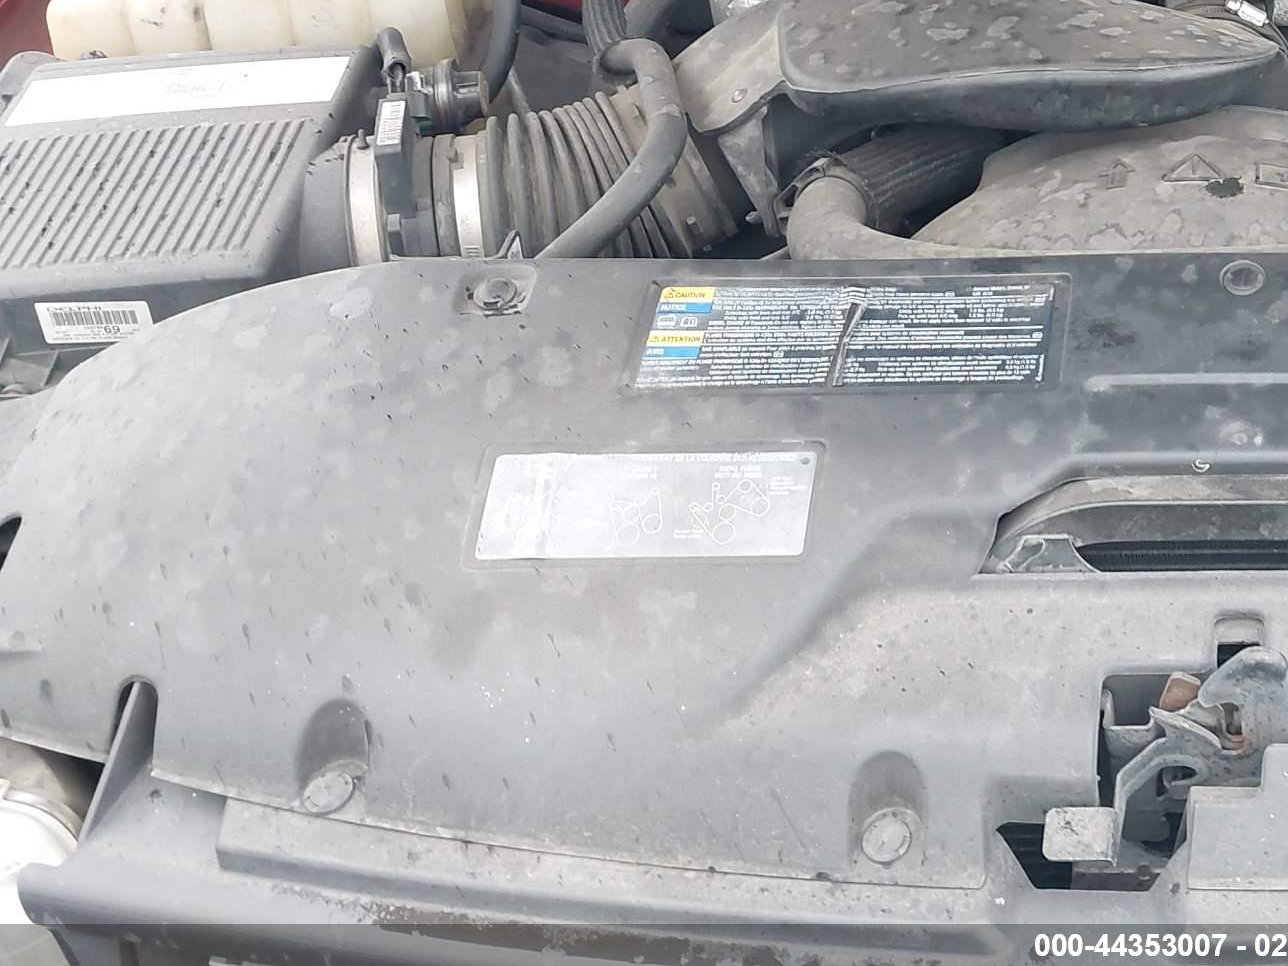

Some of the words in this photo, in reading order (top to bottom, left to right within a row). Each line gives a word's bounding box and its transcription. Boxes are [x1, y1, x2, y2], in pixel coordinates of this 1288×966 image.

[674, 291, 706, 299] CAUTION
[660, 303, 687, 311] NOTICE
[103, 325, 121, 335] 69
[661, 335, 701, 343] ATTENTION
